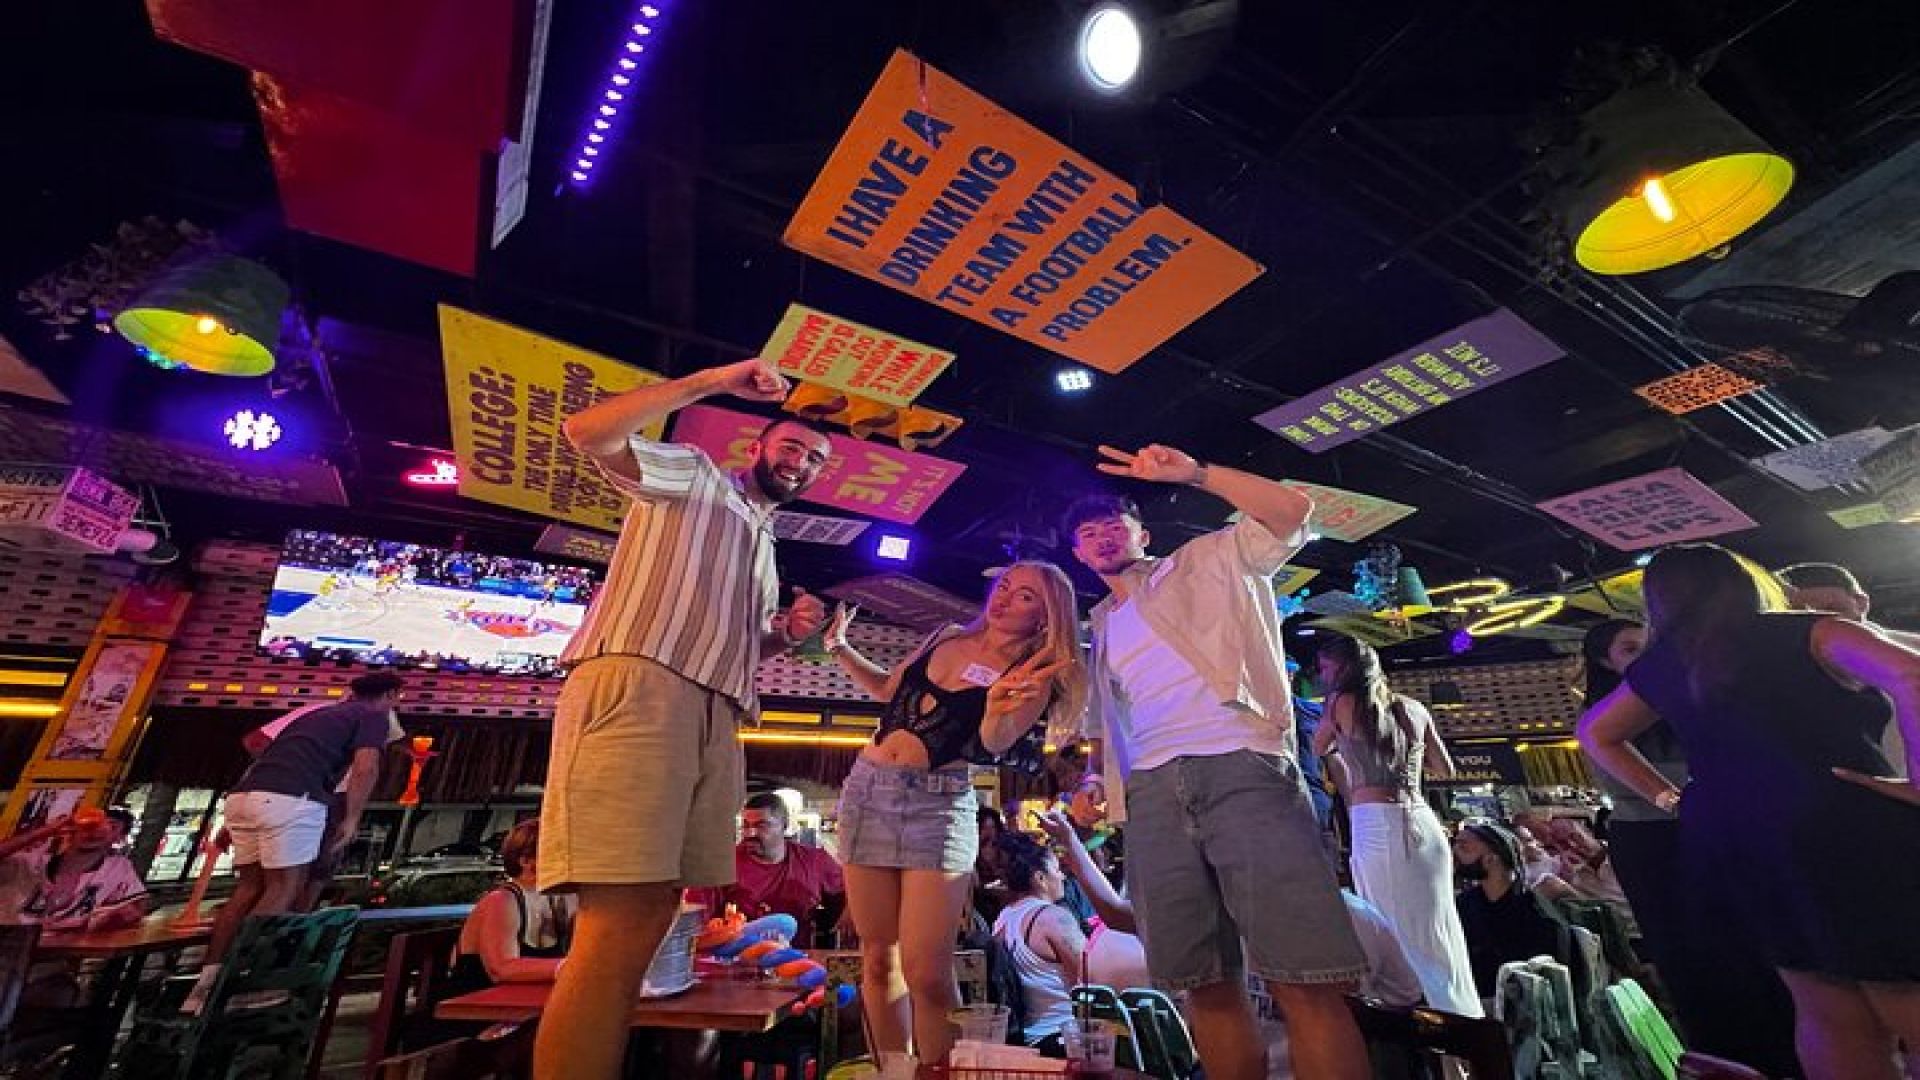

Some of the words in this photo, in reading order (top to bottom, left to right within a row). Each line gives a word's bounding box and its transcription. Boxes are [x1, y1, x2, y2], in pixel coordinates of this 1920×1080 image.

[838, 139, 930, 249] HAVE
[902, 108, 956, 150] A
[879, 145, 1018, 287] DRINKING
[936, 235, 1028, 307] TEAM
[1004, 160, 1098, 236] WITH
[991, 306, 1028, 328] A
[1011, 191, 1146, 307] FOOTBALL
[1040, 232, 1194, 342] PROBLEM.
[469, 366, 517, 485] COLLEGE:
[525, 425, 553, 466] ONLY
[527, 384, 557, 425] TIME
[523, 466, 551, 493] THE
[837, 451, 909, 505] ME
[1612, 512, 1722, 541] LIPS
[1456, 755, 1492, 766] YOU
